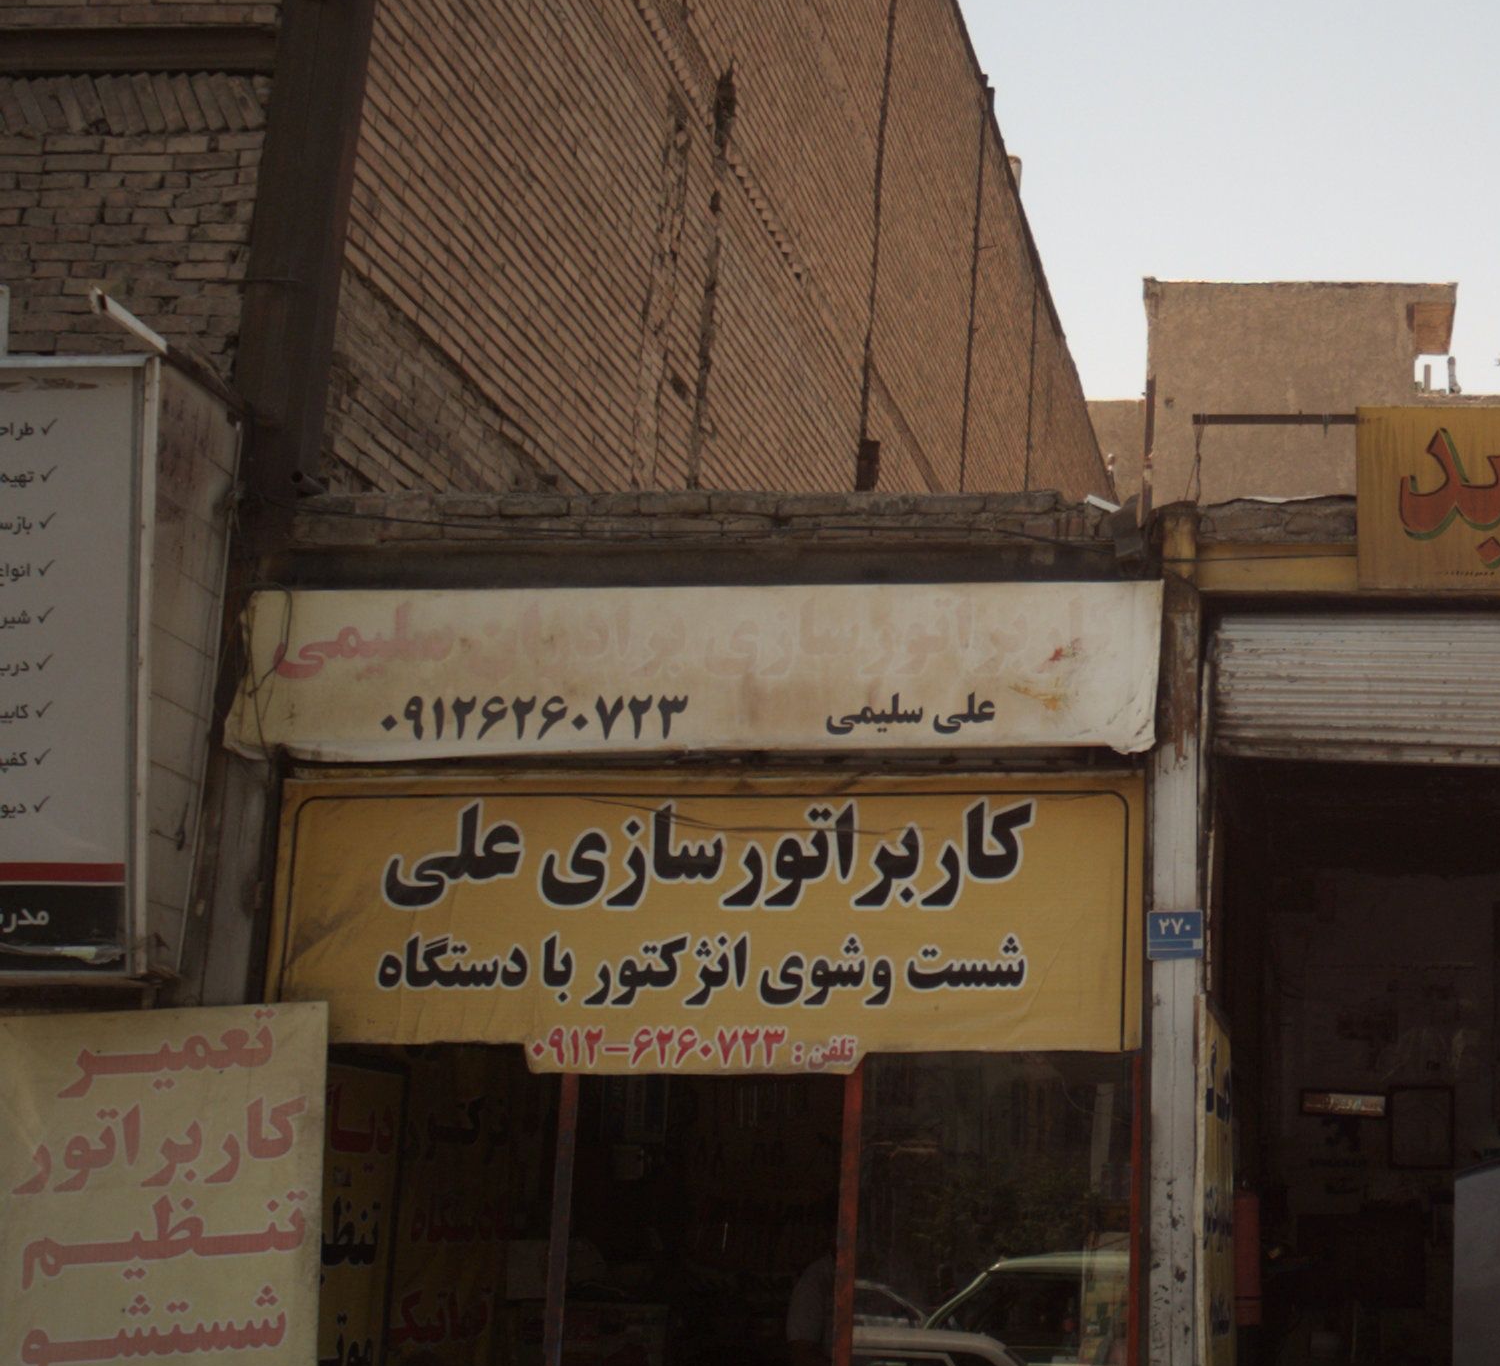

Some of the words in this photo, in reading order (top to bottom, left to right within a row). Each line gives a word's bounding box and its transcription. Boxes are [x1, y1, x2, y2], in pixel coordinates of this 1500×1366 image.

[0, 421, 35, 441] طراح
[0, 516, 33, 536] بازس
[379, 694, 689, 741] ۰۹۱۲۶۲۶۰۷۲۳
[825, 691, 924, 735] سلیمی
[932, 690, 997, 734] علی
[382, 798, 526, 911] علی
[0, 907, 51, 934] مدر
[1157, 917, 1192, 936] ۲۷۰
[376, 933, 530, 990] دستگاه
[541, 933, 576, 1002] با
[580, 934, 750, 1006] انژکتور
[905, 933, 1028, 991] شست
[57, 1008, 277, 1099] تعمیر
[11, 1095, 308, 1196] کاربراتور
[21, 1189, 309, 1291] تنظیم
